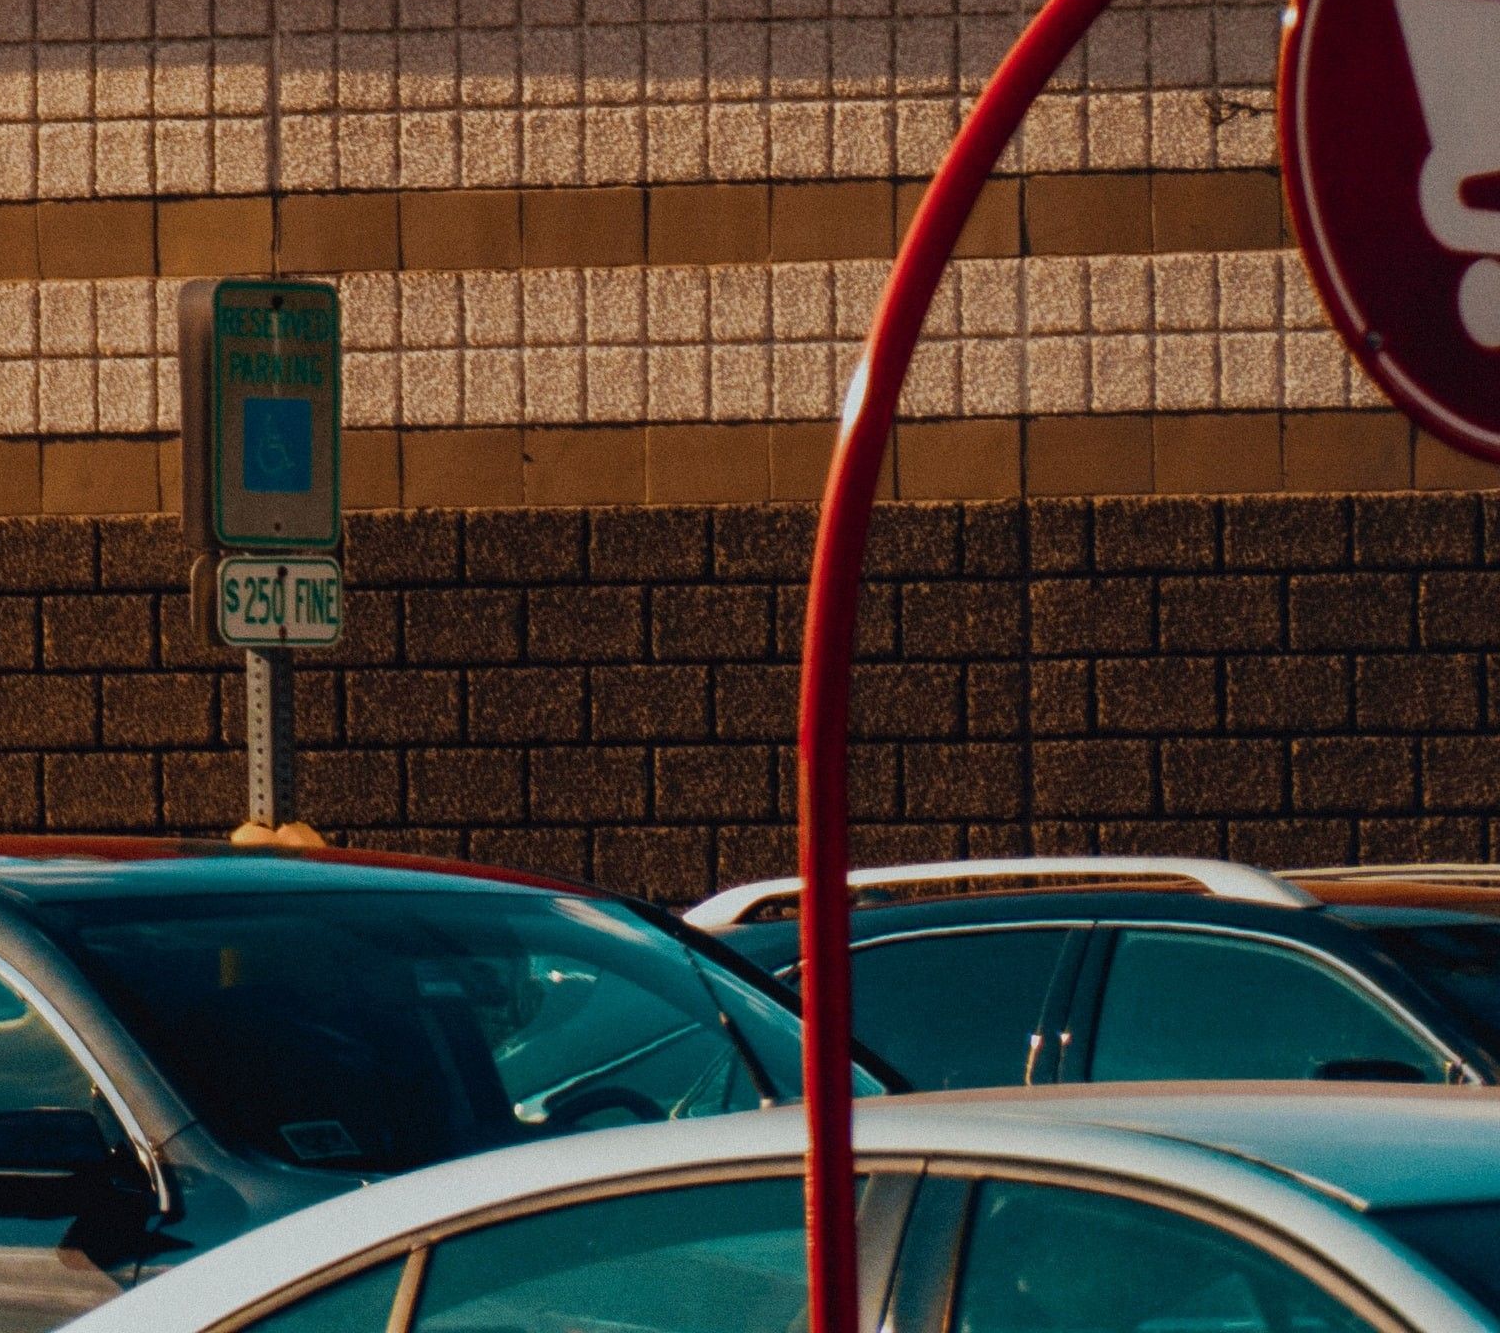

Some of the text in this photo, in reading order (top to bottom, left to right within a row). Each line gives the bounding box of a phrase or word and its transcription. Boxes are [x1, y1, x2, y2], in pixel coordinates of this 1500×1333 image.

[220, 306, 330, 341] RESERVED
[228, 352, 325, 386] PARKING
[295, 577, 340, 625] FINE
